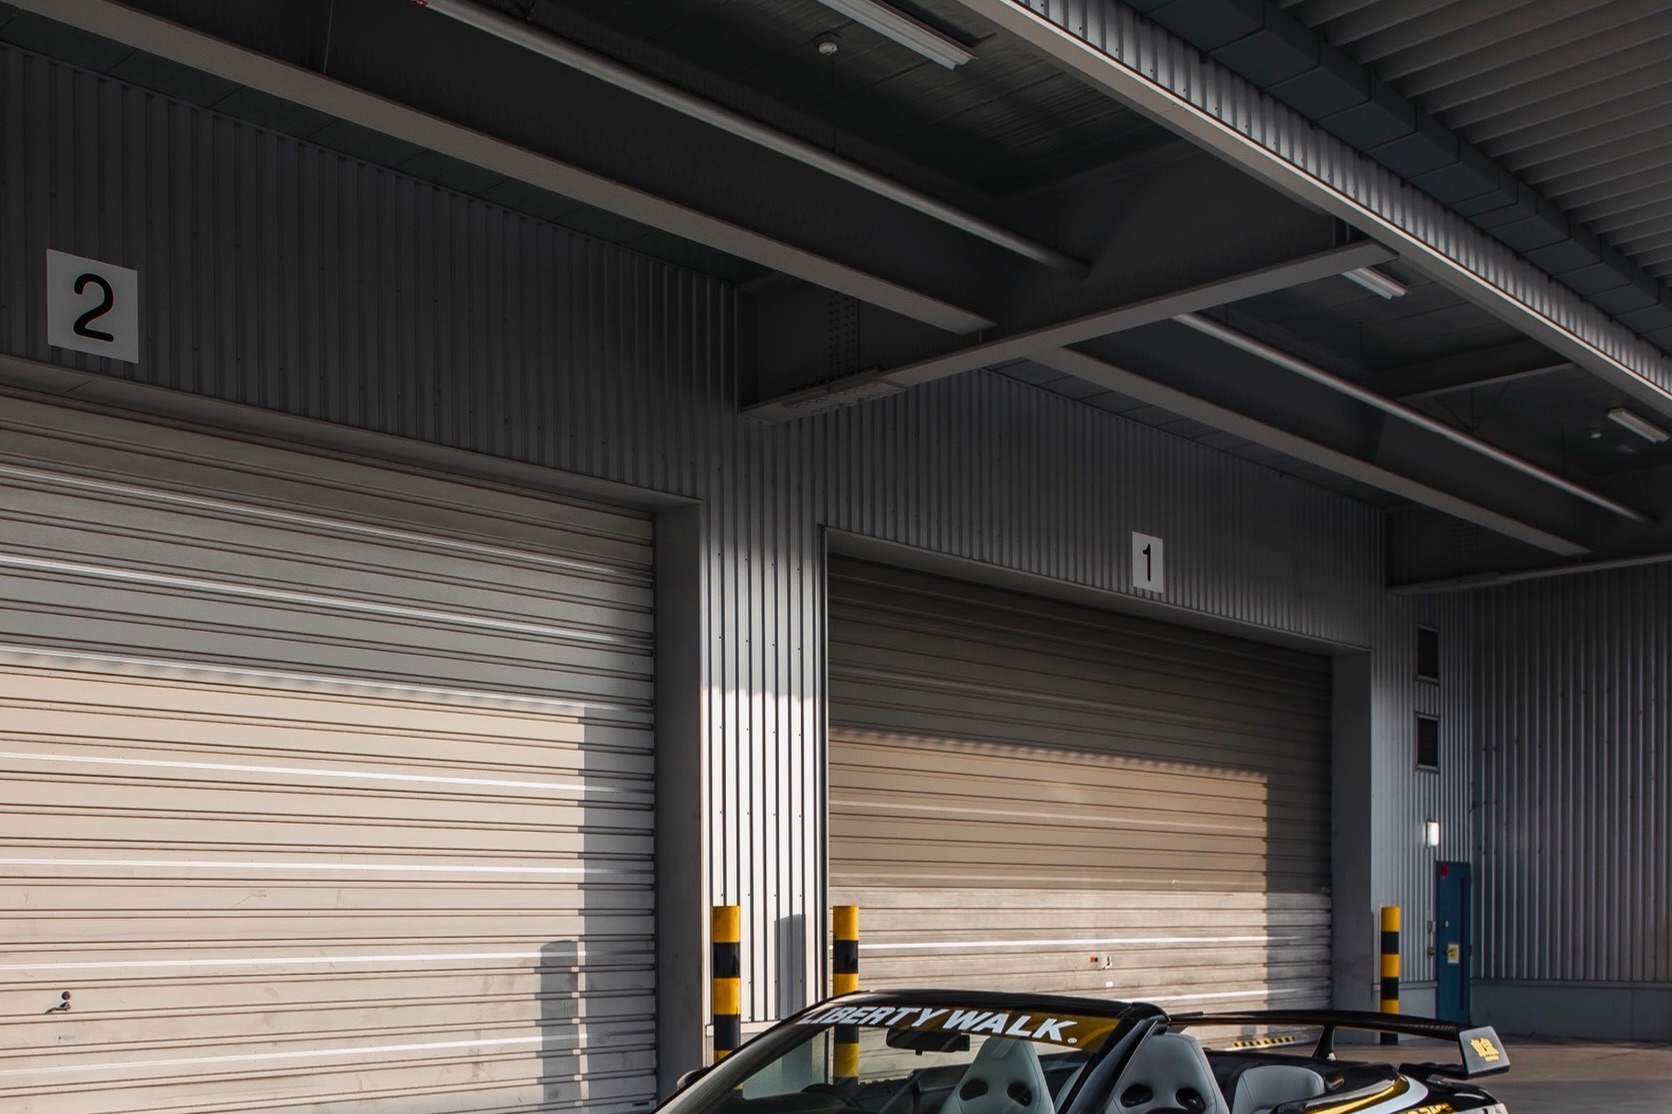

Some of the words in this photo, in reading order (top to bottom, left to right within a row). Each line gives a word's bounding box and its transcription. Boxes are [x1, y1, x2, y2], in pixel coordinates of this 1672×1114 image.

[73, 273, 115, 342] 2
[1142, 543, 1152, 582] 1
[794, 1006, 950, 1028] LIBERTY
